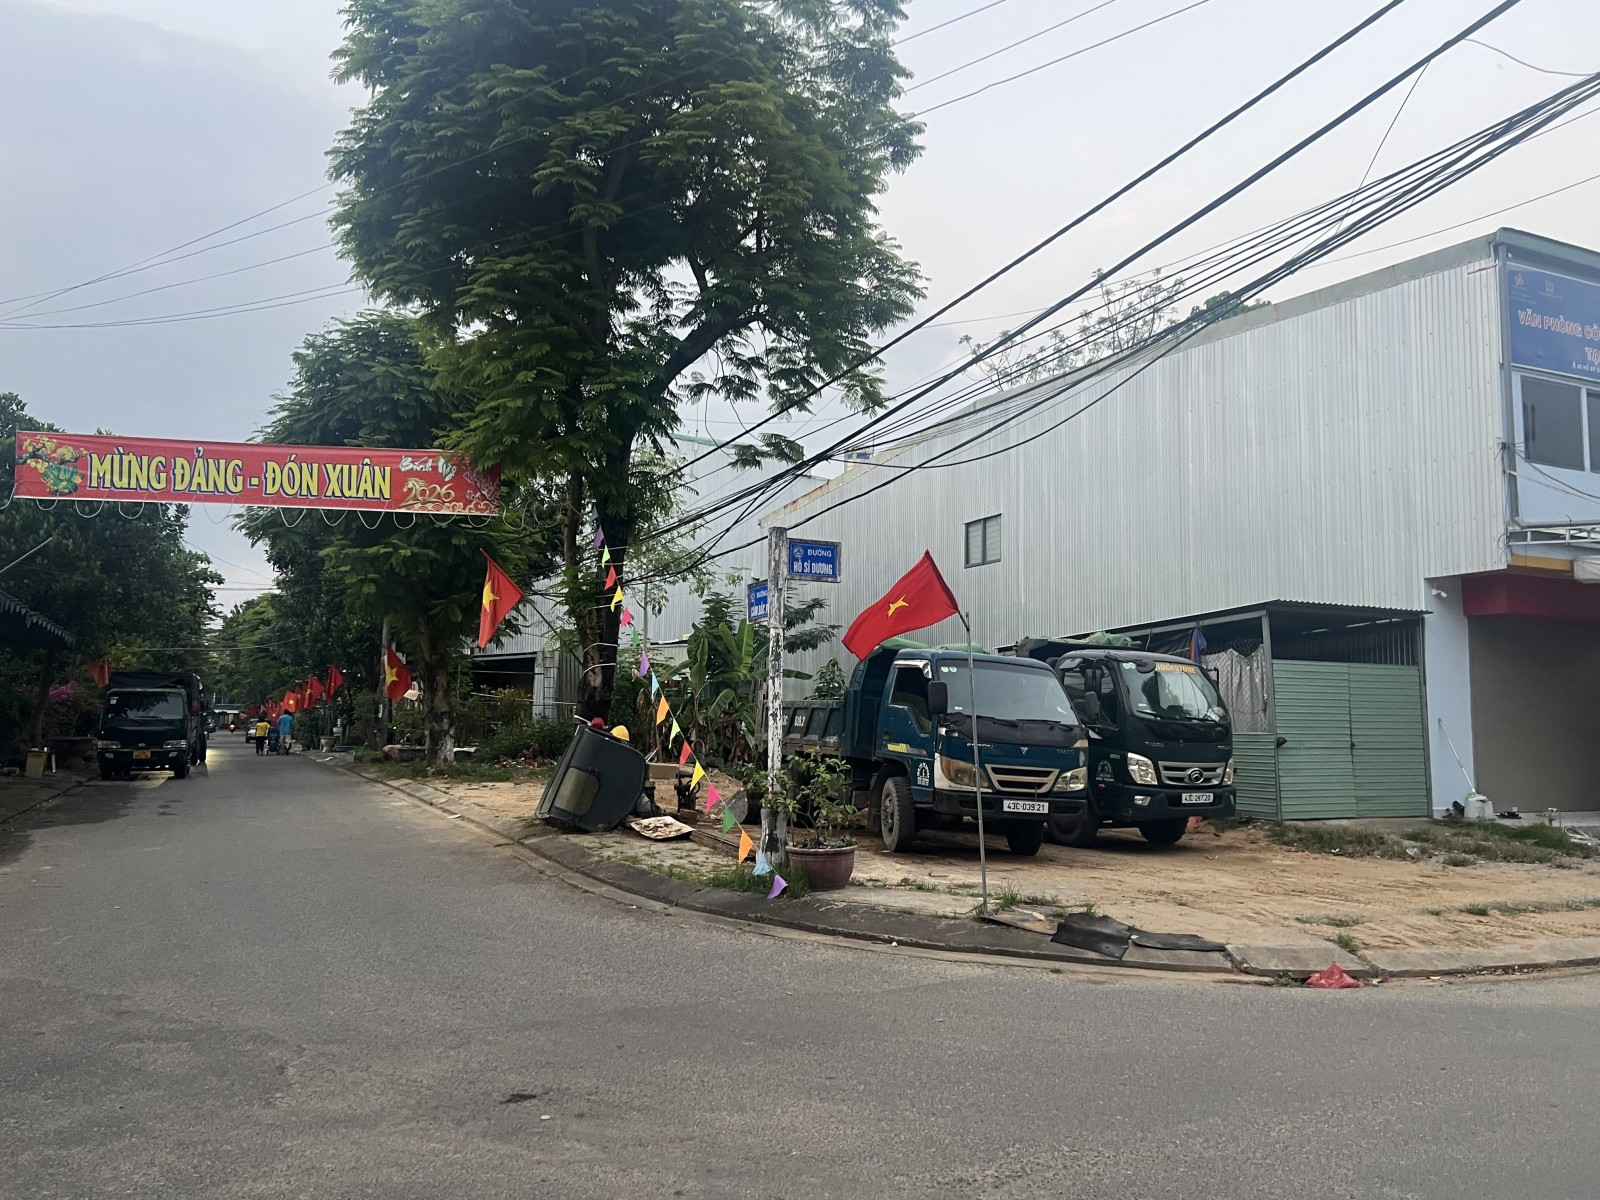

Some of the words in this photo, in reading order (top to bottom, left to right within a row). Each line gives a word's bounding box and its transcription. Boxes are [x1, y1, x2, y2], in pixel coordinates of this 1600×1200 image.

[1517, 308, 1542, 328] VĂN
[1543, 315, 1583, 338] PHÒNG
[1584, 323, 1600, 341] CÔ
[88, 446, 167, 490] MỪNG
[172, 446, 244, 494] ĐẢNG
[262, 454, 319, 498] ĐÓN
[323, 456, 391, 501] XUÂN
[400, 477, 455, 507] 2026
[793, 557, 802, 573] HỒ
[811, 562, 833, 575] DƯƠNG
[807, 548, 832, 557] ĐƯỜNG
